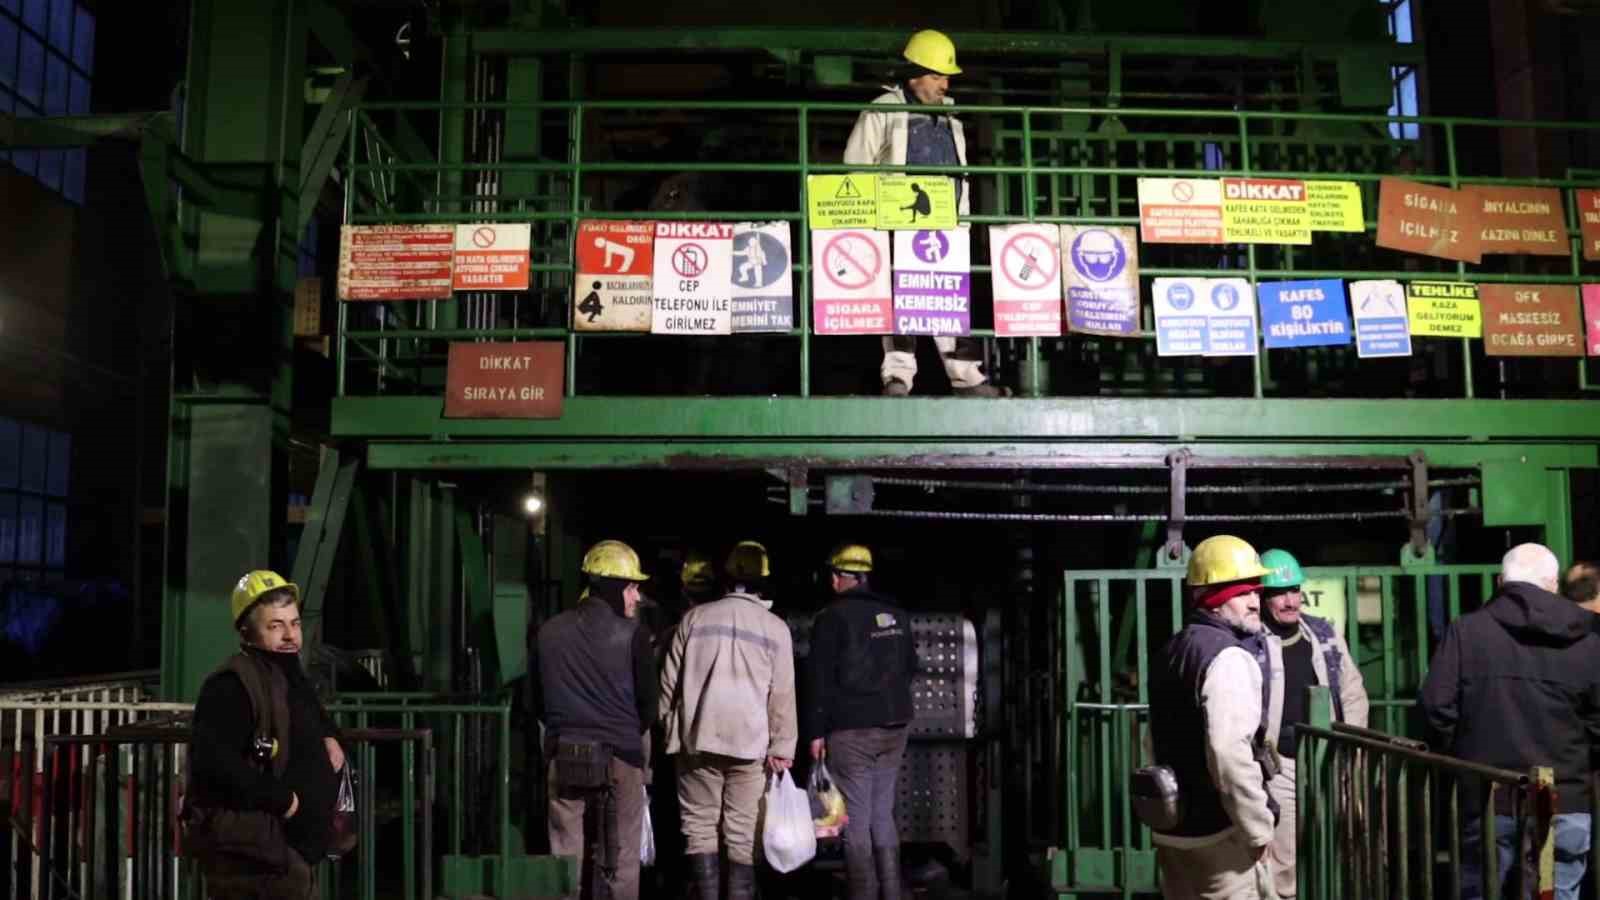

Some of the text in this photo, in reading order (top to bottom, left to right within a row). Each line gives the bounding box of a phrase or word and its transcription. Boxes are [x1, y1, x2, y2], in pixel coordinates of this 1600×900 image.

[1226, 181, 1303, 200] DİKKAT
[1226, 204, 1248, 214] KAFES
[1270, 205, 1306, 214] GELMEDEN
[656, 223, 734, 238] DİKKAT
[679, 280, 700, 292] CEP
[899, 272, 963, 290] EMNİYET
[1279, 289, 1325, 303] KAFES
[1411, 284, 1475, 298] TEHLİKE
[655, 296, 729, 311] TELEFONU İLE
[826, 302, 881, 314] SİGARA
[895, 293, 968, 312] KEMERSİZ
[1431, 301, 1457, 310] KAZA
[665, 316, 716, 330] GİRİLMEZ
[770, 315, 792, 326] TAK
[824, 316, 886, 330] İÇİLMEZ
[1416, 312, 1474, 322] GELİYORUM
[1499, 311, 1561, 325] MASKESİZ
[899, 316, 963, 335] ÇALIŞMA
[1269, 320, 1345, 339] KİŞİLİKTİR
[1429, 323, 1463, 332] DEMEZ
[1491, 331, 1535, 346] OCAĞA
[479, 353, 532, 370] DİKKAT
[463, 384, 545, 401] SIRAYA GİR
